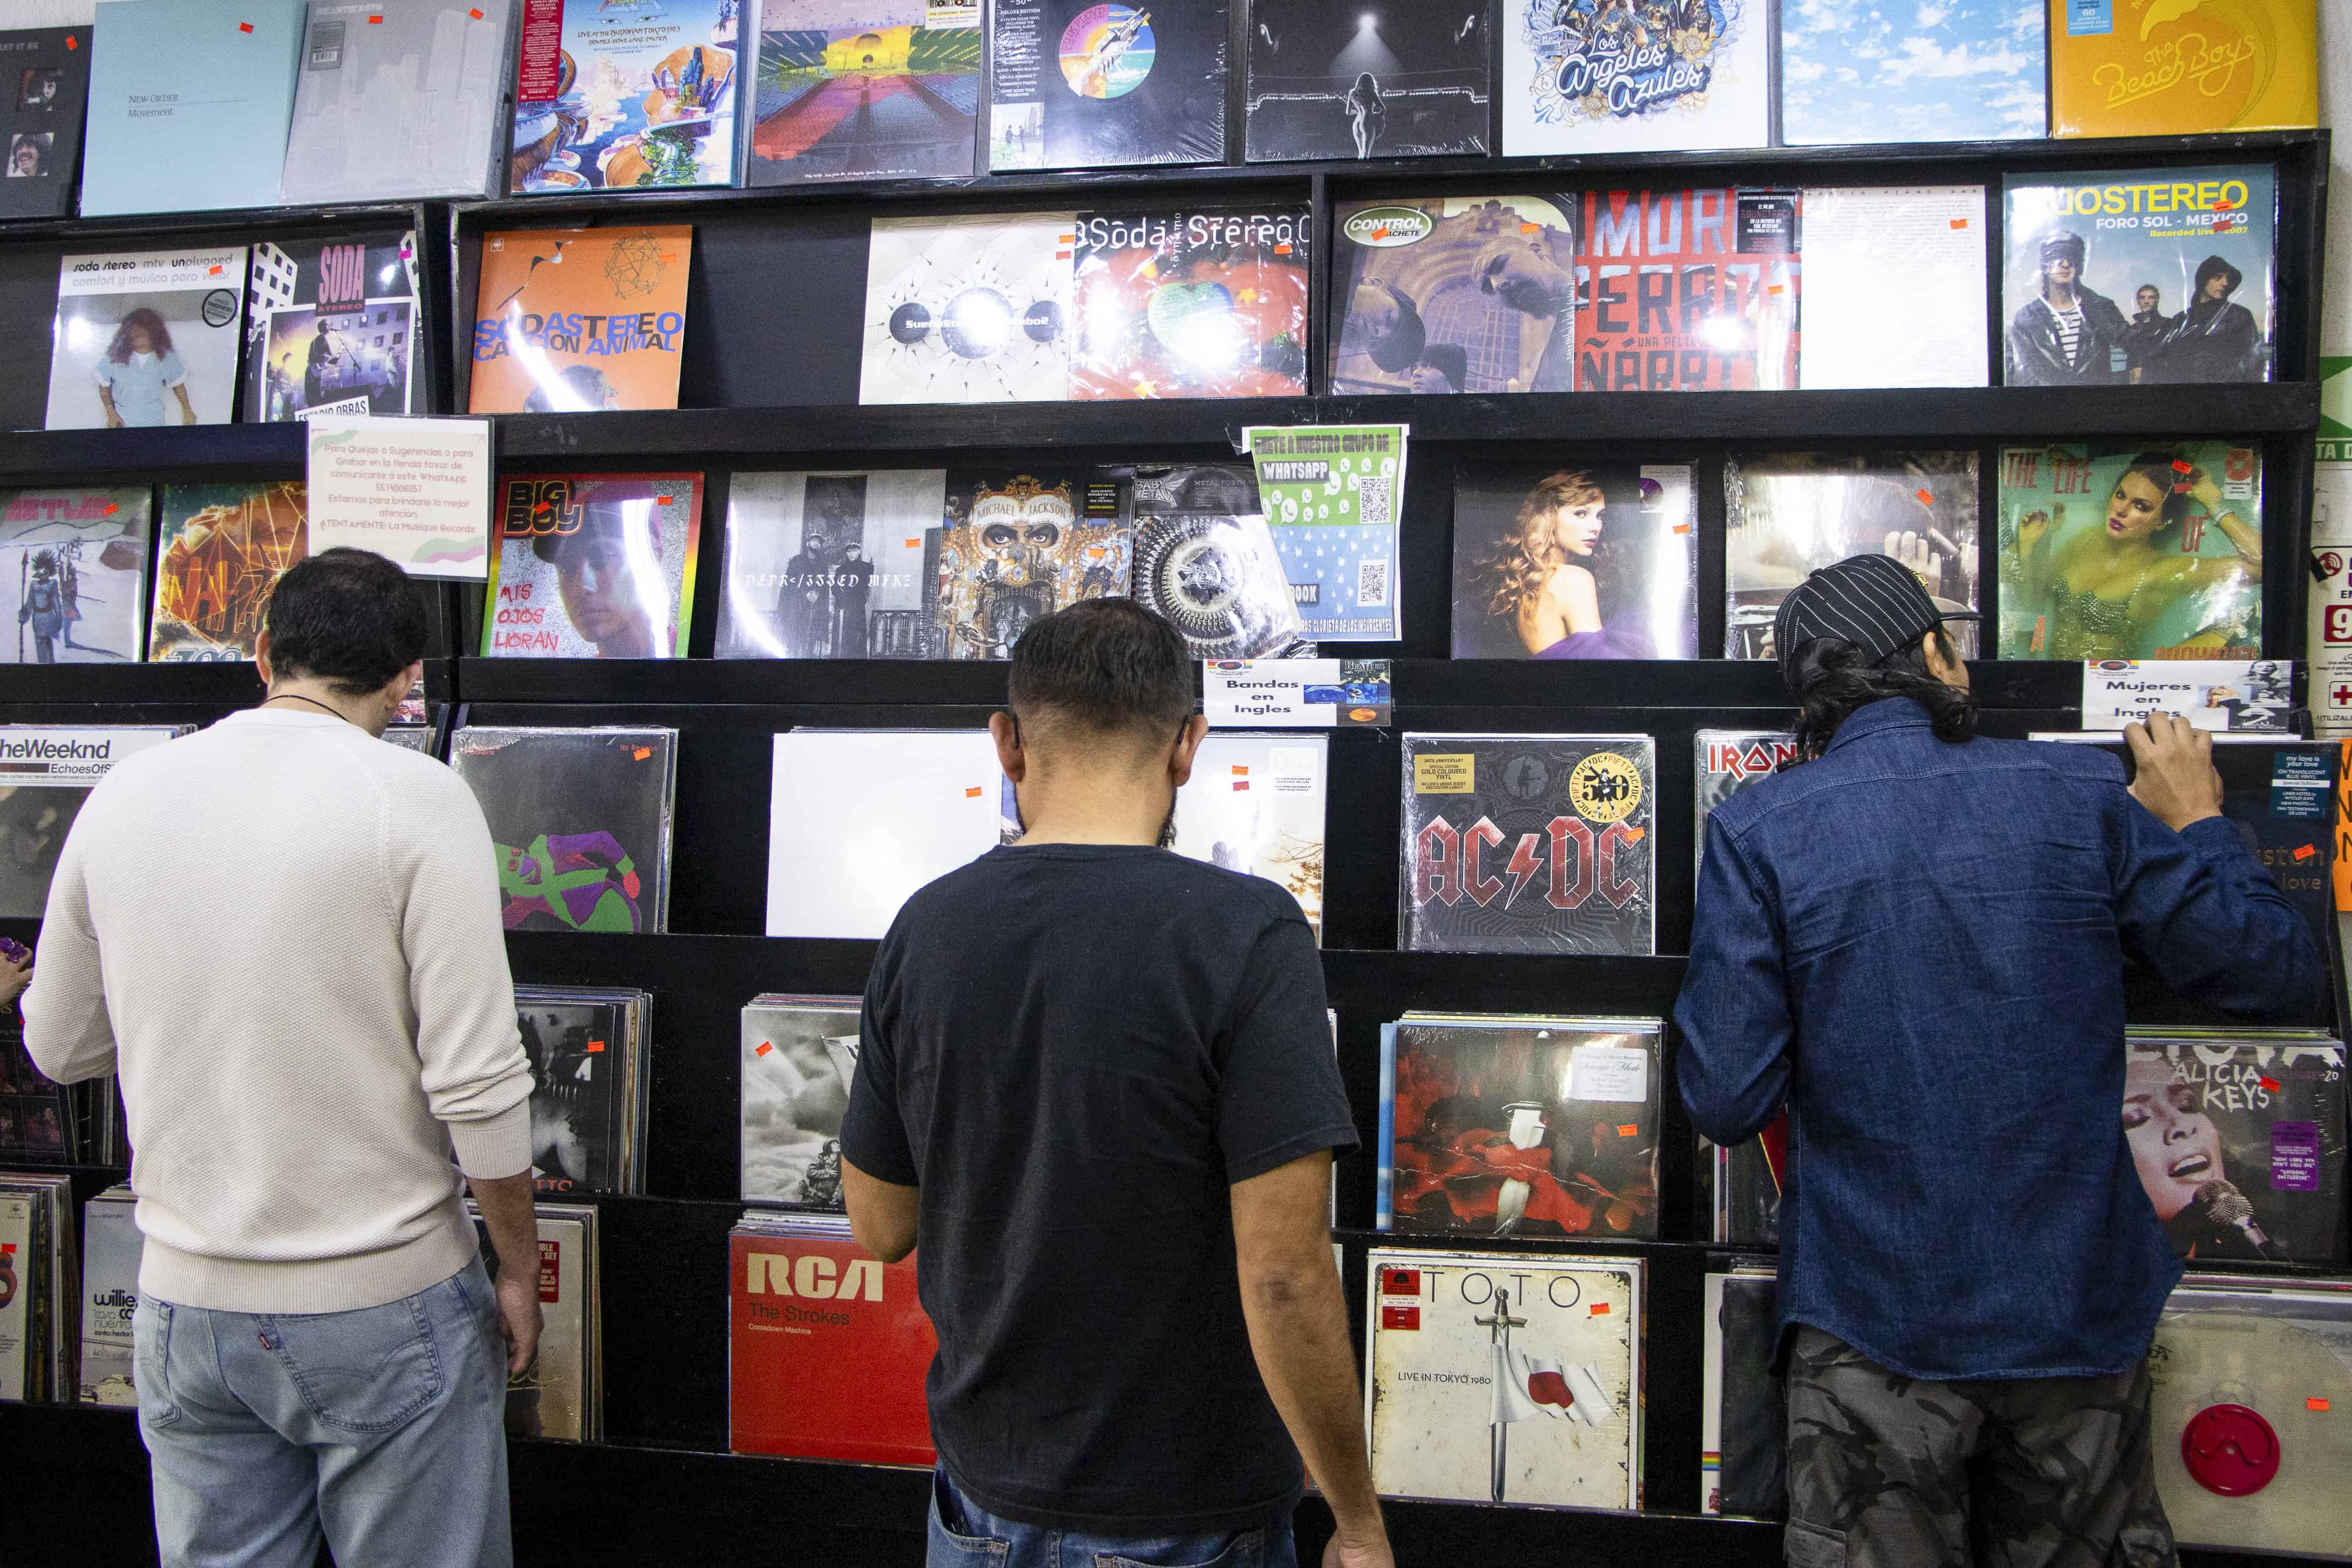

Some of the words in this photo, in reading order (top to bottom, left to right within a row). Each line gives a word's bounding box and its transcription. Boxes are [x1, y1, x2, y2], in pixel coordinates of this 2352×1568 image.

[1588, 30, 1621, 58] Los
[2144, 42, 2174, 67] The
[2092, 60, 2185, 109] Beach
[2176, 34, 2257, 98] Boys
[1607, 63, 1703, 111] Azules
[129, 95, 148, 103] NEW
[150, 94, 179, 103] ORDER
[129, 108, 173, 118] Movement
[1350, 218, 1424, 230] CONTROL
[2096, 218, 2139, 229] FORO
[2143, 216, 2172, 228] SOL
[2186, 213, 2249, 226] MEXICO
[2150, 229, 2194, 238] Recorded
[74, 261, 99, 273] soda
[103, 259, 136, 270] stereo
[143, 257, 165, 269] mtv
[320, 244, 365, 304] SODA
[318, 303, 363, 312] STEREO
[584, 333, 676, 356] ANIMAL
[325, 444, 346, 453] Para
[348, 446, 379, 456] Quejas
[389, 447, 442, 458] Sugerencias
[452, 450, 474, 459] para
[1296, 434, 1339, 454] NUESTRO
[1342, 434, 1375, 453] GRUPO
[1376, 434, 1389, 452] DE
[336, 457, 367, 466] Grabar
[393, 460, 422, 469] tienda
[424, 461, 449, 469] favor
[450, 461, 463, 470] de
[1262, 462, 1328, 481] WHATSAPP
[330, 471, 386, 480] comunicarse
[420, 473, 467, 484] WhatsApp
[2004, 452, 2040, 490] THE
[2053, 457, 2094, 494] LIFE
[1135, 477, 1170, 490] BABY
[328, 494, 368, 503] Estamos
[369, 496, 390, 506] para
[392, 497, 432, 507] brindarle
[433, 499, 441, 507] la
[443, 500, 470, 509] mejor
[507, 480, 568, 509] BIG
[978, 503, 1017, 518] MICHAEL
[1029, 503, 1066, 518] JACKSON
[389, 521, 399, 530] La
[440, 524, 476, 534] Records
[503, 503, 584, 536] BOY
[2181, 516, 2209, 553] OF
[500, 583, 533, 603] MIS
[497, 608, 546, 624] OJOS
[1313, 618, 1338, 633] GLORIETA
[1339, 618, 1347, 633] DE
[1347, 618, 1357, 633] LOS
[1358, 618, 1392, 633] INSURGENTES
[2029, 616, 2046, 653] A
[1227, 679, 1299, 688] Bandas
[2106, 681, 2191, 693] Mujeres
[1234, 704, 1291, 715] Ingles
[0, 738, 111, 759] heWeeknd
[1608, 755, 1631, 771] FIFTY
[1707, 742, 1798, 783] IRON
[1582, 774, 1629, 801] 50
[2282, 873, 2322, 890] love
[2172, 1061, 2261, 1084] ALICIA
[2202, 1081, 2270, 1113] KEYS
[544, 1252, 557, 1261] SET
[747, 1252, 883, 1302] RCA
[1423, 1271, 1581, 1308] TOTO
[750, 1302, 779, 1320] The
[786, 1305, 850, 1326] Strokes
[748, 1323, 784, 1332] Comedown
[785, 1326, 812, 1335] Machine
[1398, 1372, 1419, 1382] LIVE
[1421, 1373, 1431, 1382] IN
[1434, 1374, 1469, 1383] TOKYO
[1471, 1376, 1491, 1385] 1980
